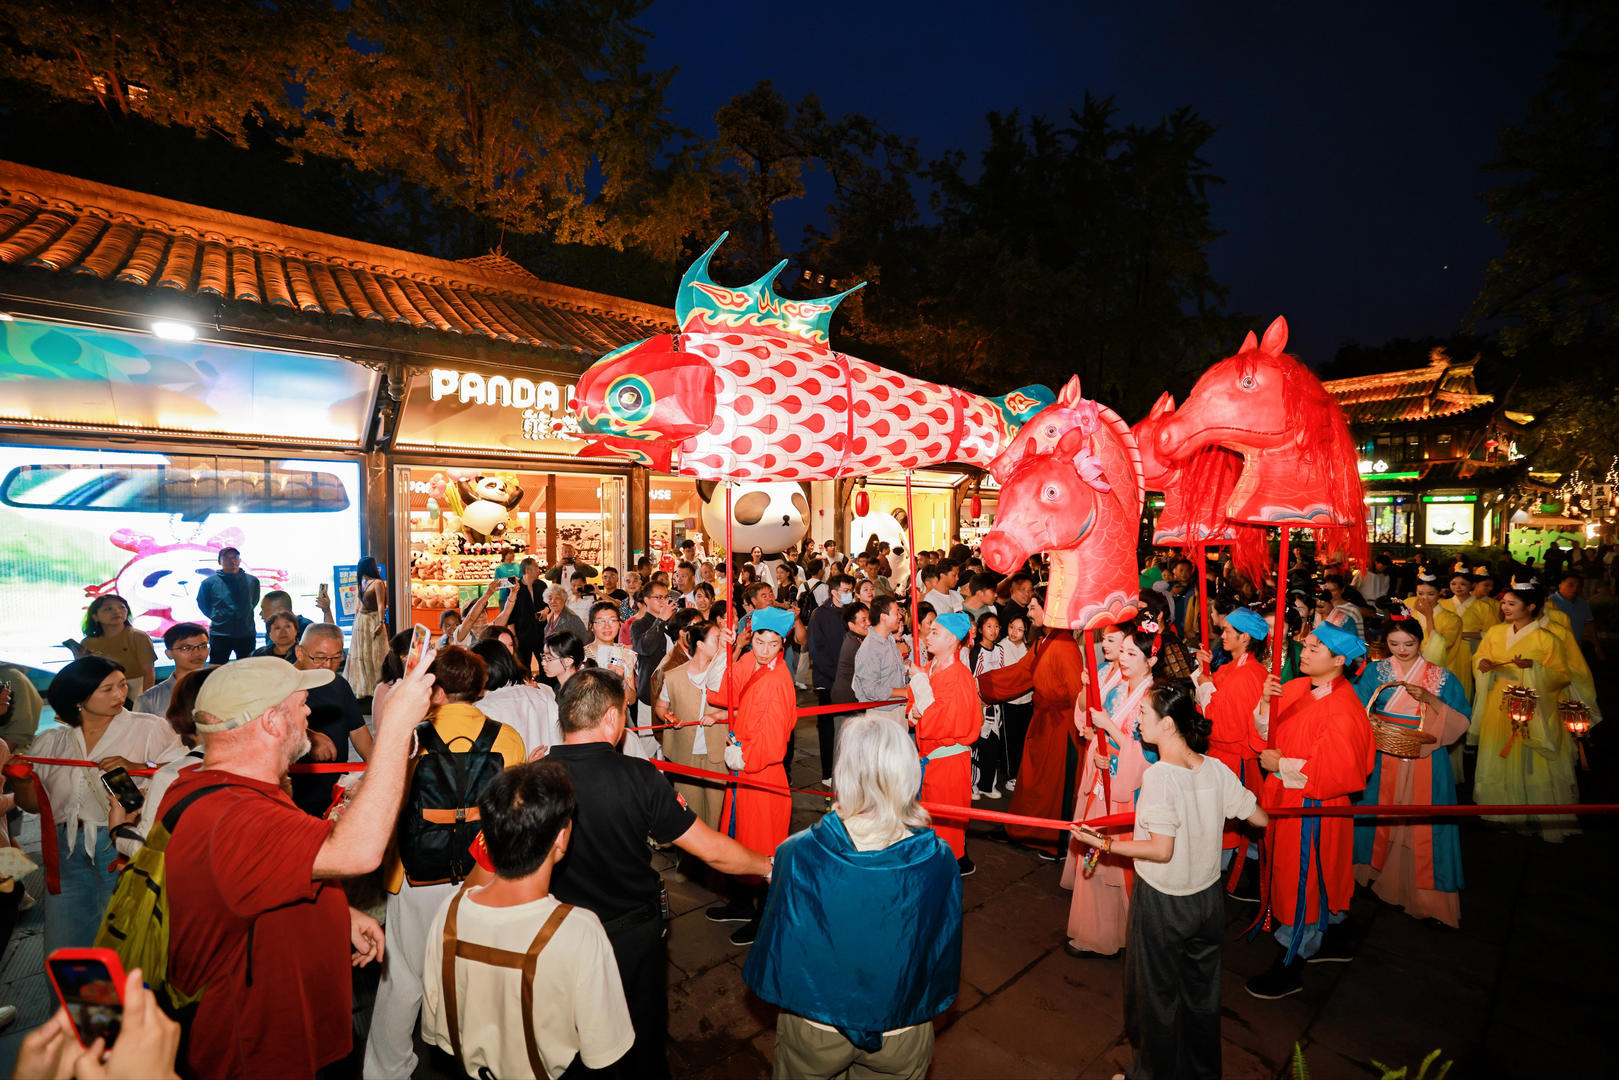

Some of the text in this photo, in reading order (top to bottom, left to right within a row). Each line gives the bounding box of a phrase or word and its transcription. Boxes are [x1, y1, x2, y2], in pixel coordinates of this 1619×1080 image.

[431, 368, 559, 412] PANDA
[522, 409, 599, 445] 熊猫
[649, 489, 672, 500] USE
